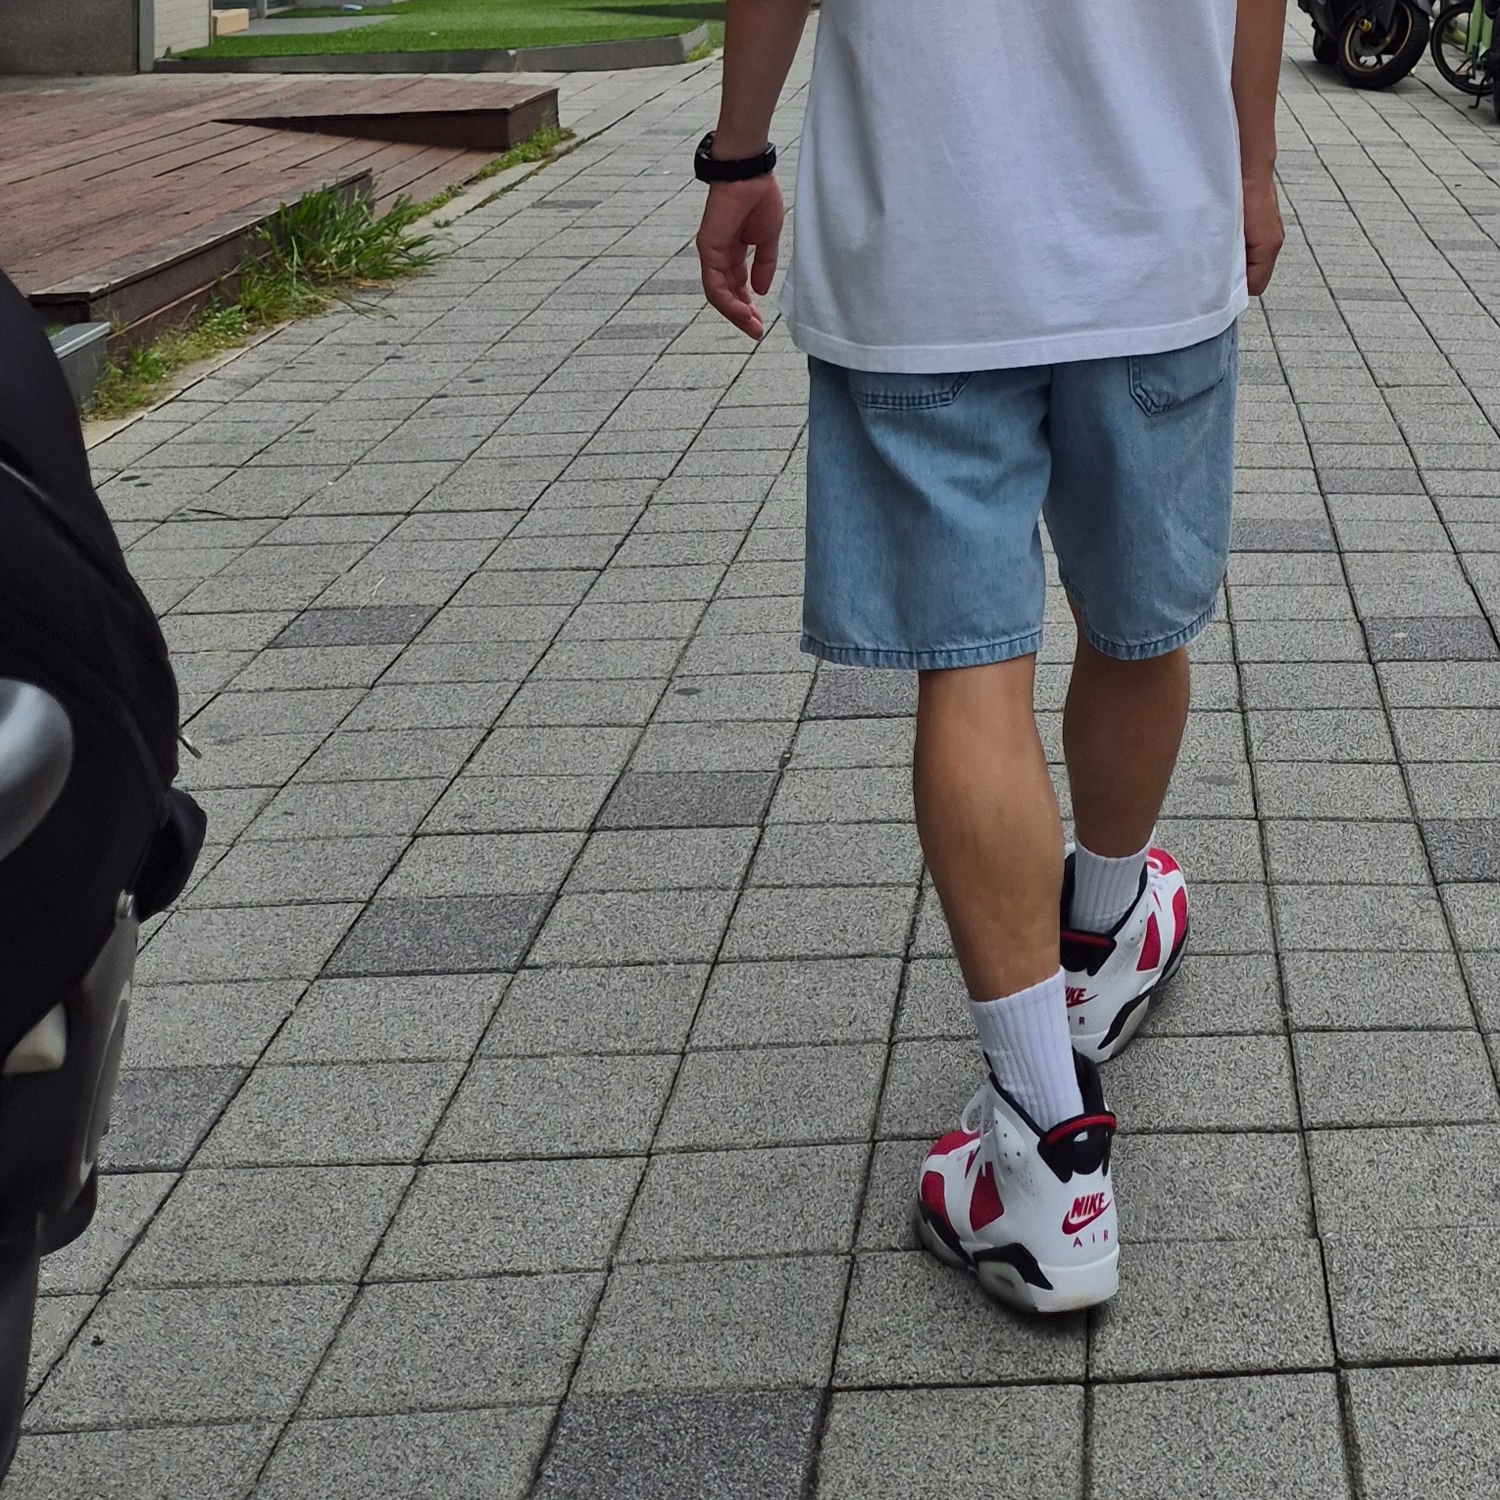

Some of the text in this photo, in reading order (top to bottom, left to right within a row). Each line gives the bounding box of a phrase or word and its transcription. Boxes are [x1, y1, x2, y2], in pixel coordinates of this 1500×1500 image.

[1065, 986, 1087, 1004] IKE
[1070, 1192, 1105, 1219] NIKE
[1073, 1229, 1109, 1249] AIR
